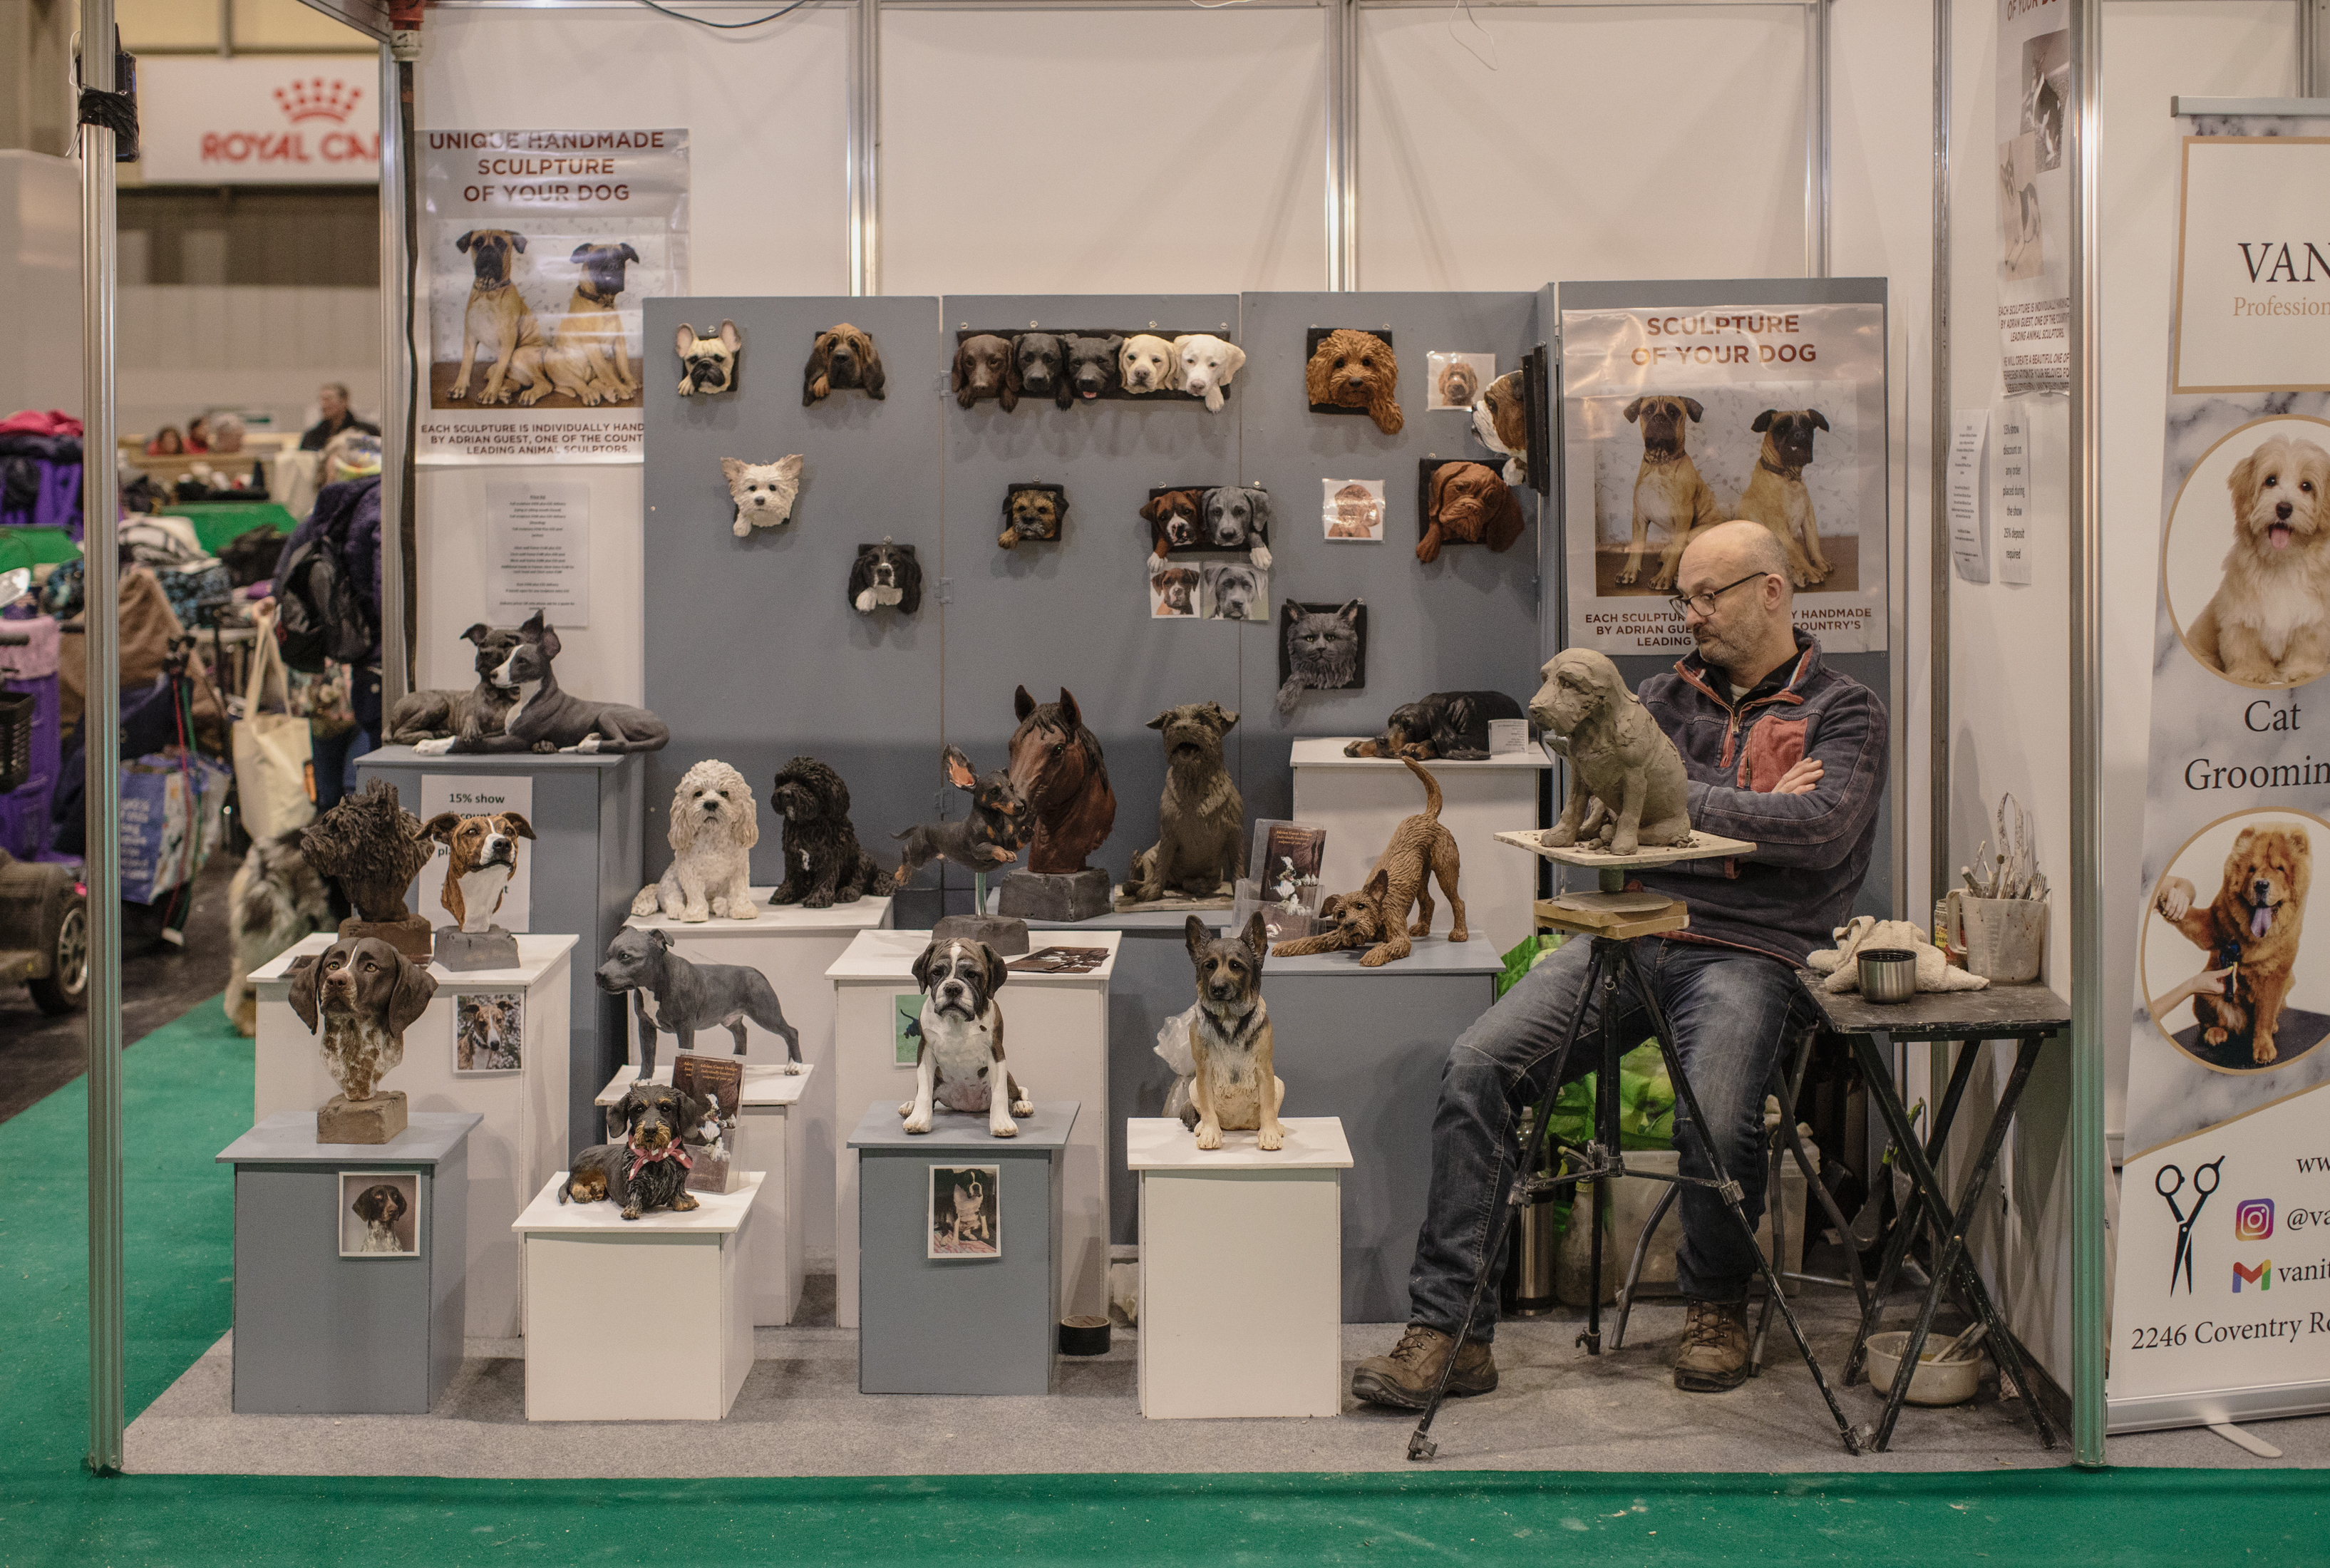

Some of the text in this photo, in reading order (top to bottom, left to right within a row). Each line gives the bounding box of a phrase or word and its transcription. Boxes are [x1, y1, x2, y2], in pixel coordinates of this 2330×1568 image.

[201, 130, 310, 162] ROYAL
[528, 131, 664, 149] HANDMADE
[478, 158, 615, 175] SCULPTURE
[464, 184, 630, 202] OF YOUR DOG
[2237, 242, 2330, 284] VAN
[1998, 306, 2009, 316] EACH
[2009, 303, 2031, 315] SCULPTURE
[2031, 302, 2035, 312] IS
[1646, 314, 1800, 336] SCULPTURE
[2000, 319, 2006, 329] BY
[2006, 317, 2020, 328] ADRIAN
[2034, 315, 2043, 326] ONE
[2043, 314, 2048, 325] OF
[2010, 331, 2026, 341] LEADING
[2026, 329, 2041, 341] ANIMAL
[1631, 343, 1817, 366] OF YOUR DOG
[2016, 355, 2029, 366] CREATE
[2032, 353, 2053, 364] BEAUTIFUL
[2053, 353, 2063, 363] ONE
[421, 423, 644, 433] EACH SCULPTURE IS INDIVIDUALLY HAND
[2010, 423, 2019, 434] show
[431, 433, 644, 445] BY ADRIAN GUEST, ONE OF THE COUNT
[467, 445, 631, 455] LEADING ANIMAL SCULPTORS.
[2003, 444, 2022, 455] discount on
[2012, 463, 2021, 475] order
[2003, 485, 2025, 498] placed during
[2013, 505, 2022, 516] show
[2011, 527, 2025, 542] deposit
[2006, 547, 2021, 561] required
[1585, 614, 1618, 624] EACH
[1801, 608, 1872, 619] HANDMADE
[1597, 626, 1612, 635] BY
[1616, 625, 1664, 634] ADRIAN
[1637, 636, 1691, 646] LEADING
[2244, 700, 2301, 732] Cat
[2185, 755, 2330, 790] Groomin
[449, 793, 505, 803] 15% show
[2130, 1324, 2187, 1349] 2246
[2195, 1317, 2303, 1343] Coventry
